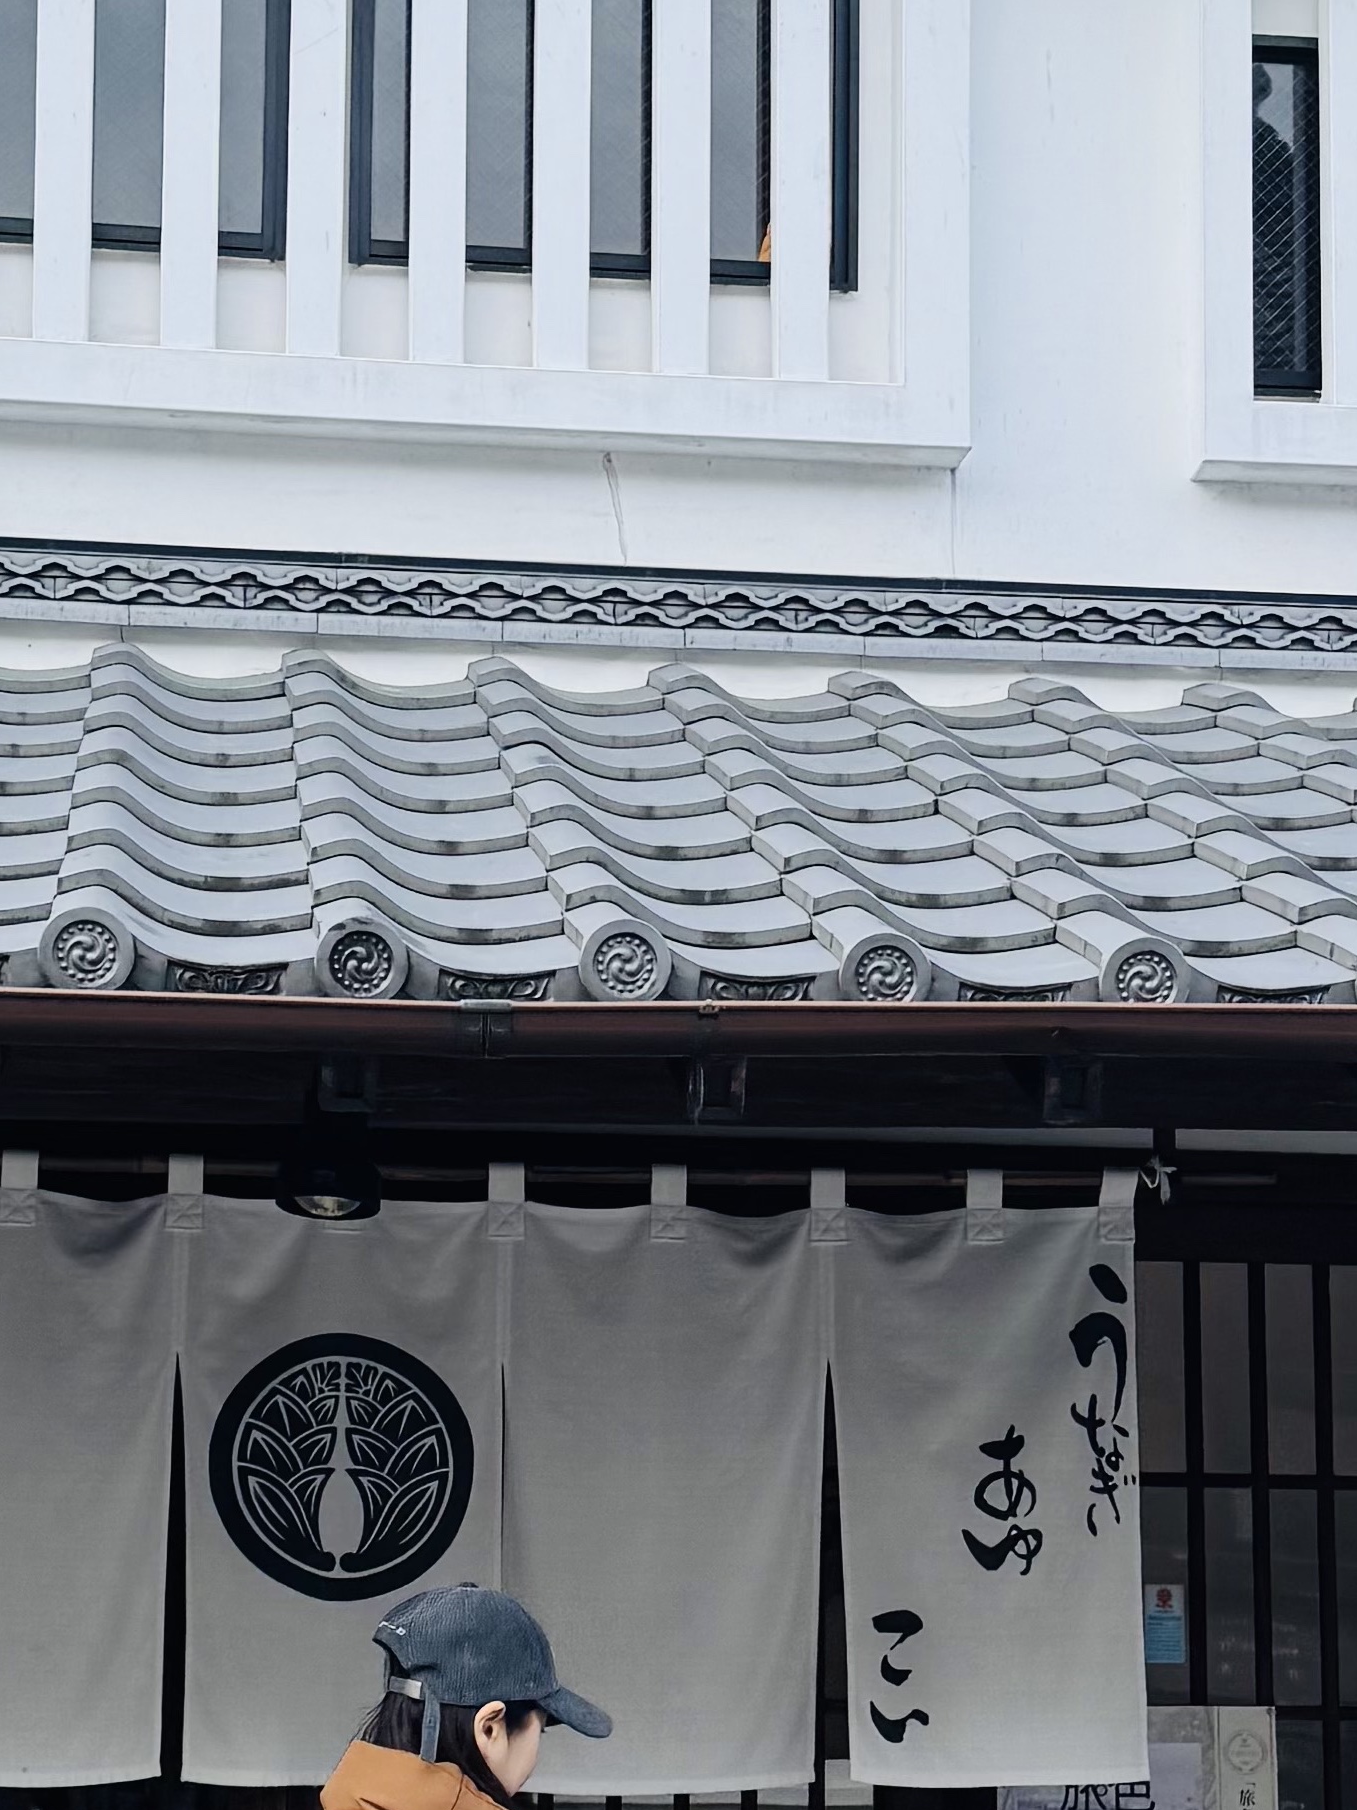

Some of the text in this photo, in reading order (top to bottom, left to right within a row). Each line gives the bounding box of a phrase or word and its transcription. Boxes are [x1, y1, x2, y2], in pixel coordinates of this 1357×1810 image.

[1069, 1263, 1139, 1537] うなぎ
[961, 1424, 1043, 1576] あゆ
[869, 1609, 930, 1744] こい
